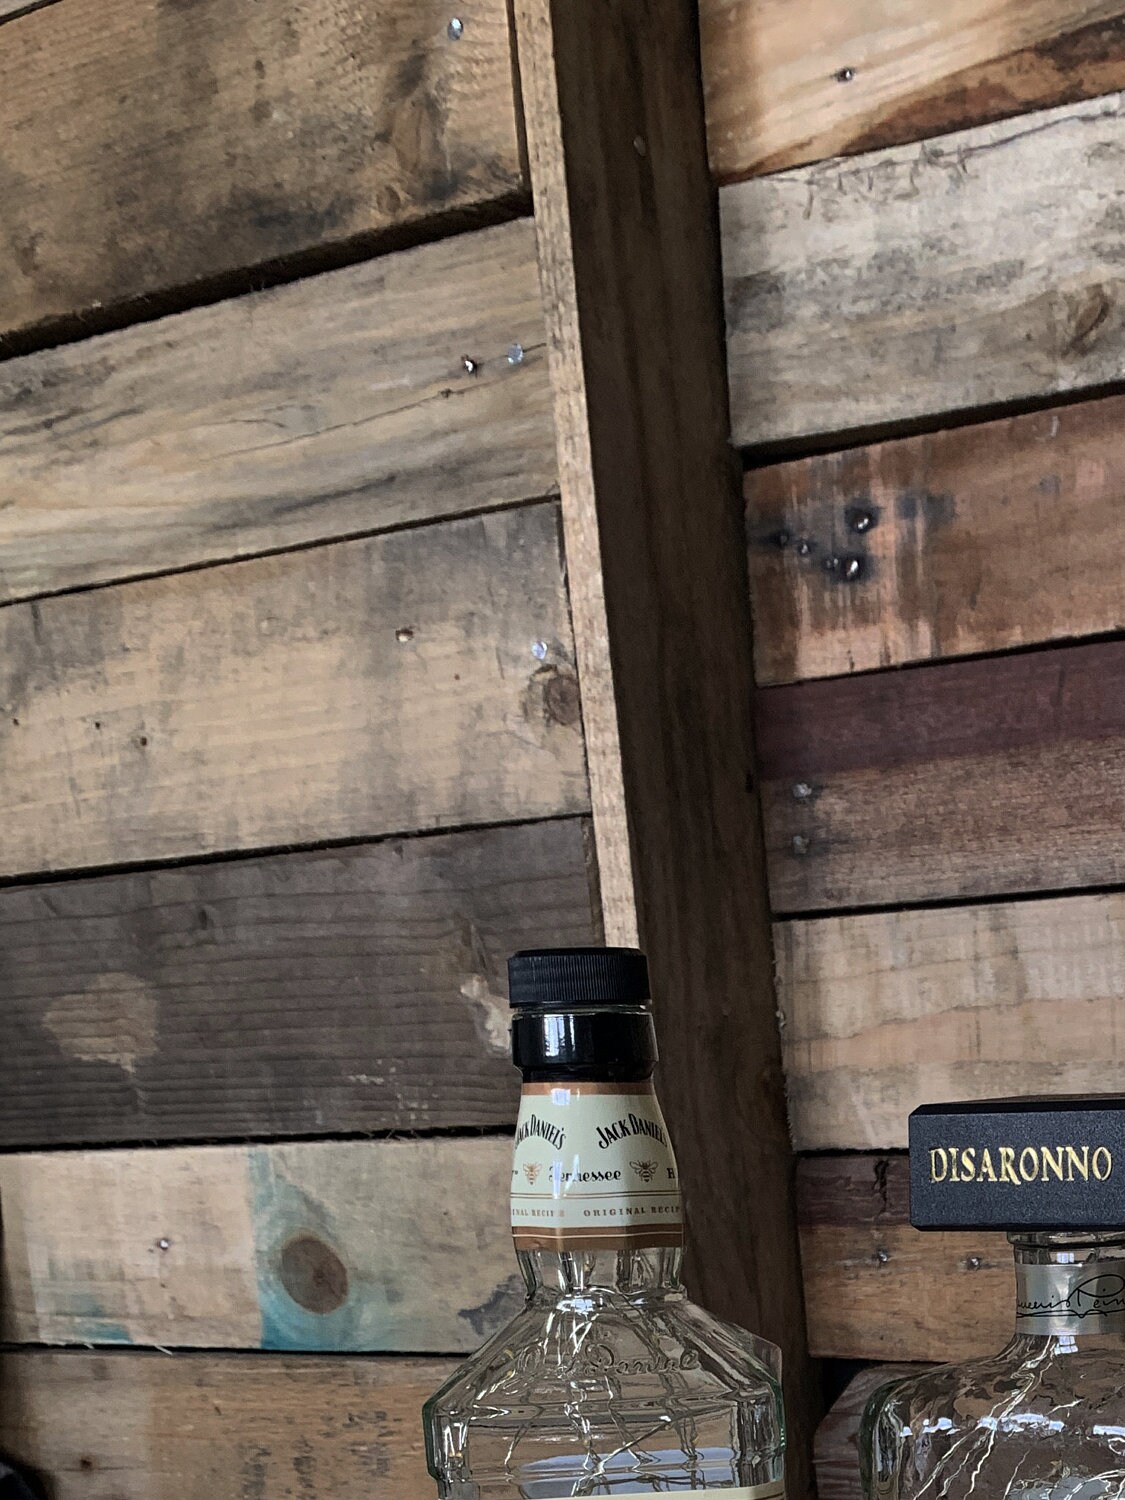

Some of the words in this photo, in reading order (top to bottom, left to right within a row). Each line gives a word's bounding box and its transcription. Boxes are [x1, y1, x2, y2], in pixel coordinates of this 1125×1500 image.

[596, 1119, 631, 1149] JACK
[928, 1146, 1113, 1185] DISARONNO
[583, 1206, 646, 1217] ORIGINAL
[651, 1206, 680, 1214] RECIP
